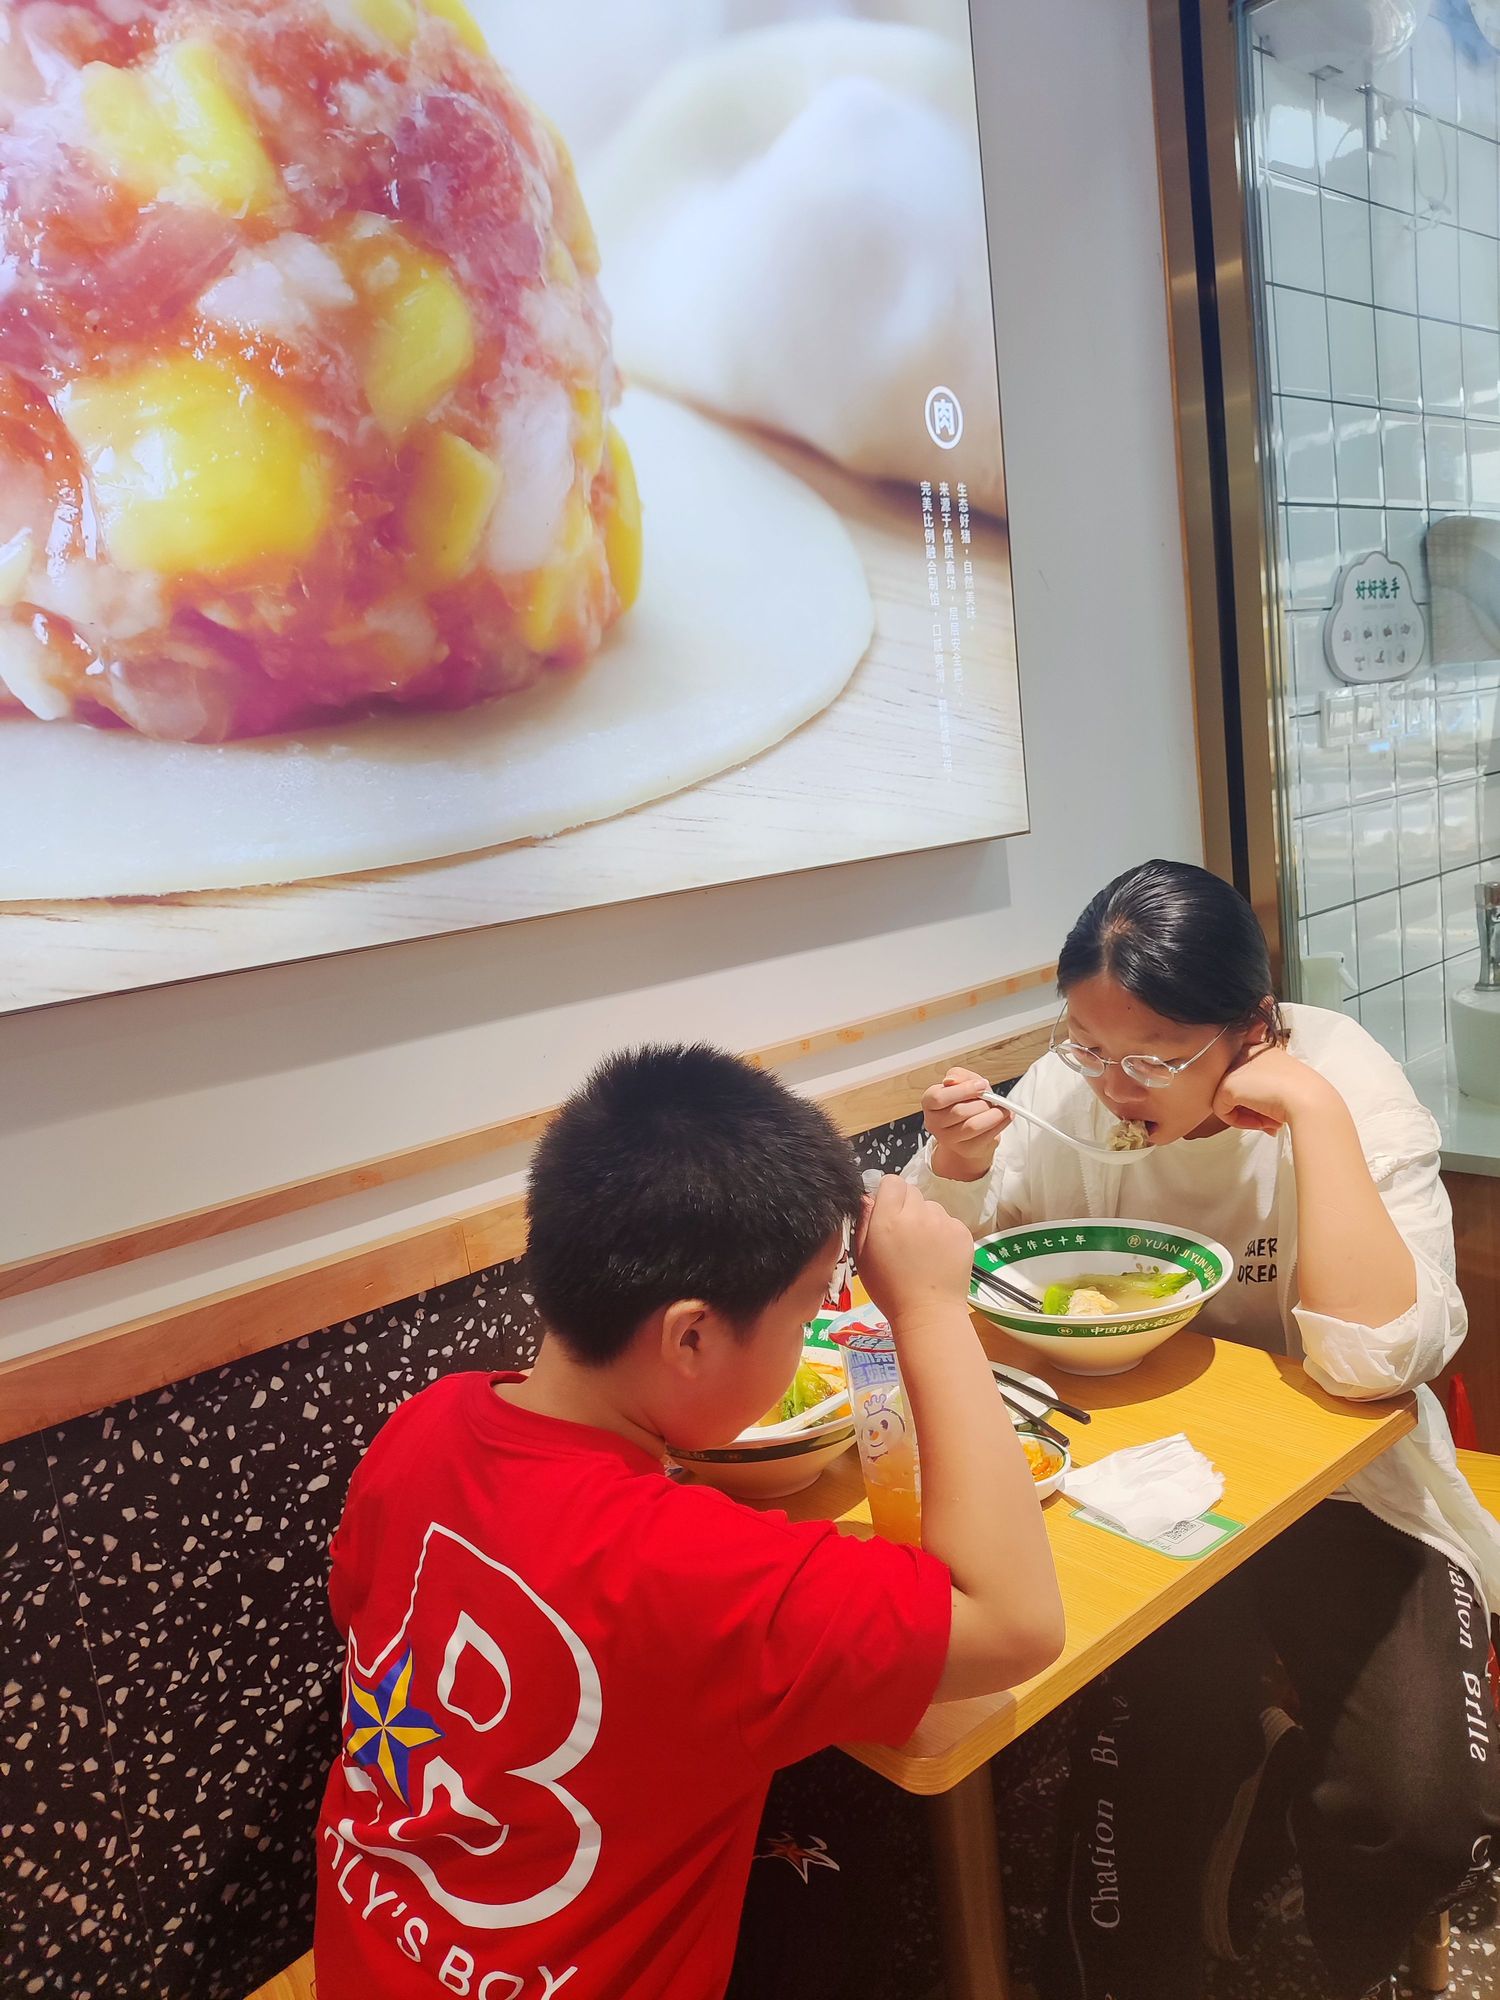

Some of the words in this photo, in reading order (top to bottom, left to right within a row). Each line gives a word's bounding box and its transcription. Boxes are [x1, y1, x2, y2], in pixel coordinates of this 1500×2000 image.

[1355, 577, 1400, 600] 好好洗手
[1145, 1239, 1180, 1255] YUAN
[438, 1945, 578, 2000] BOY
